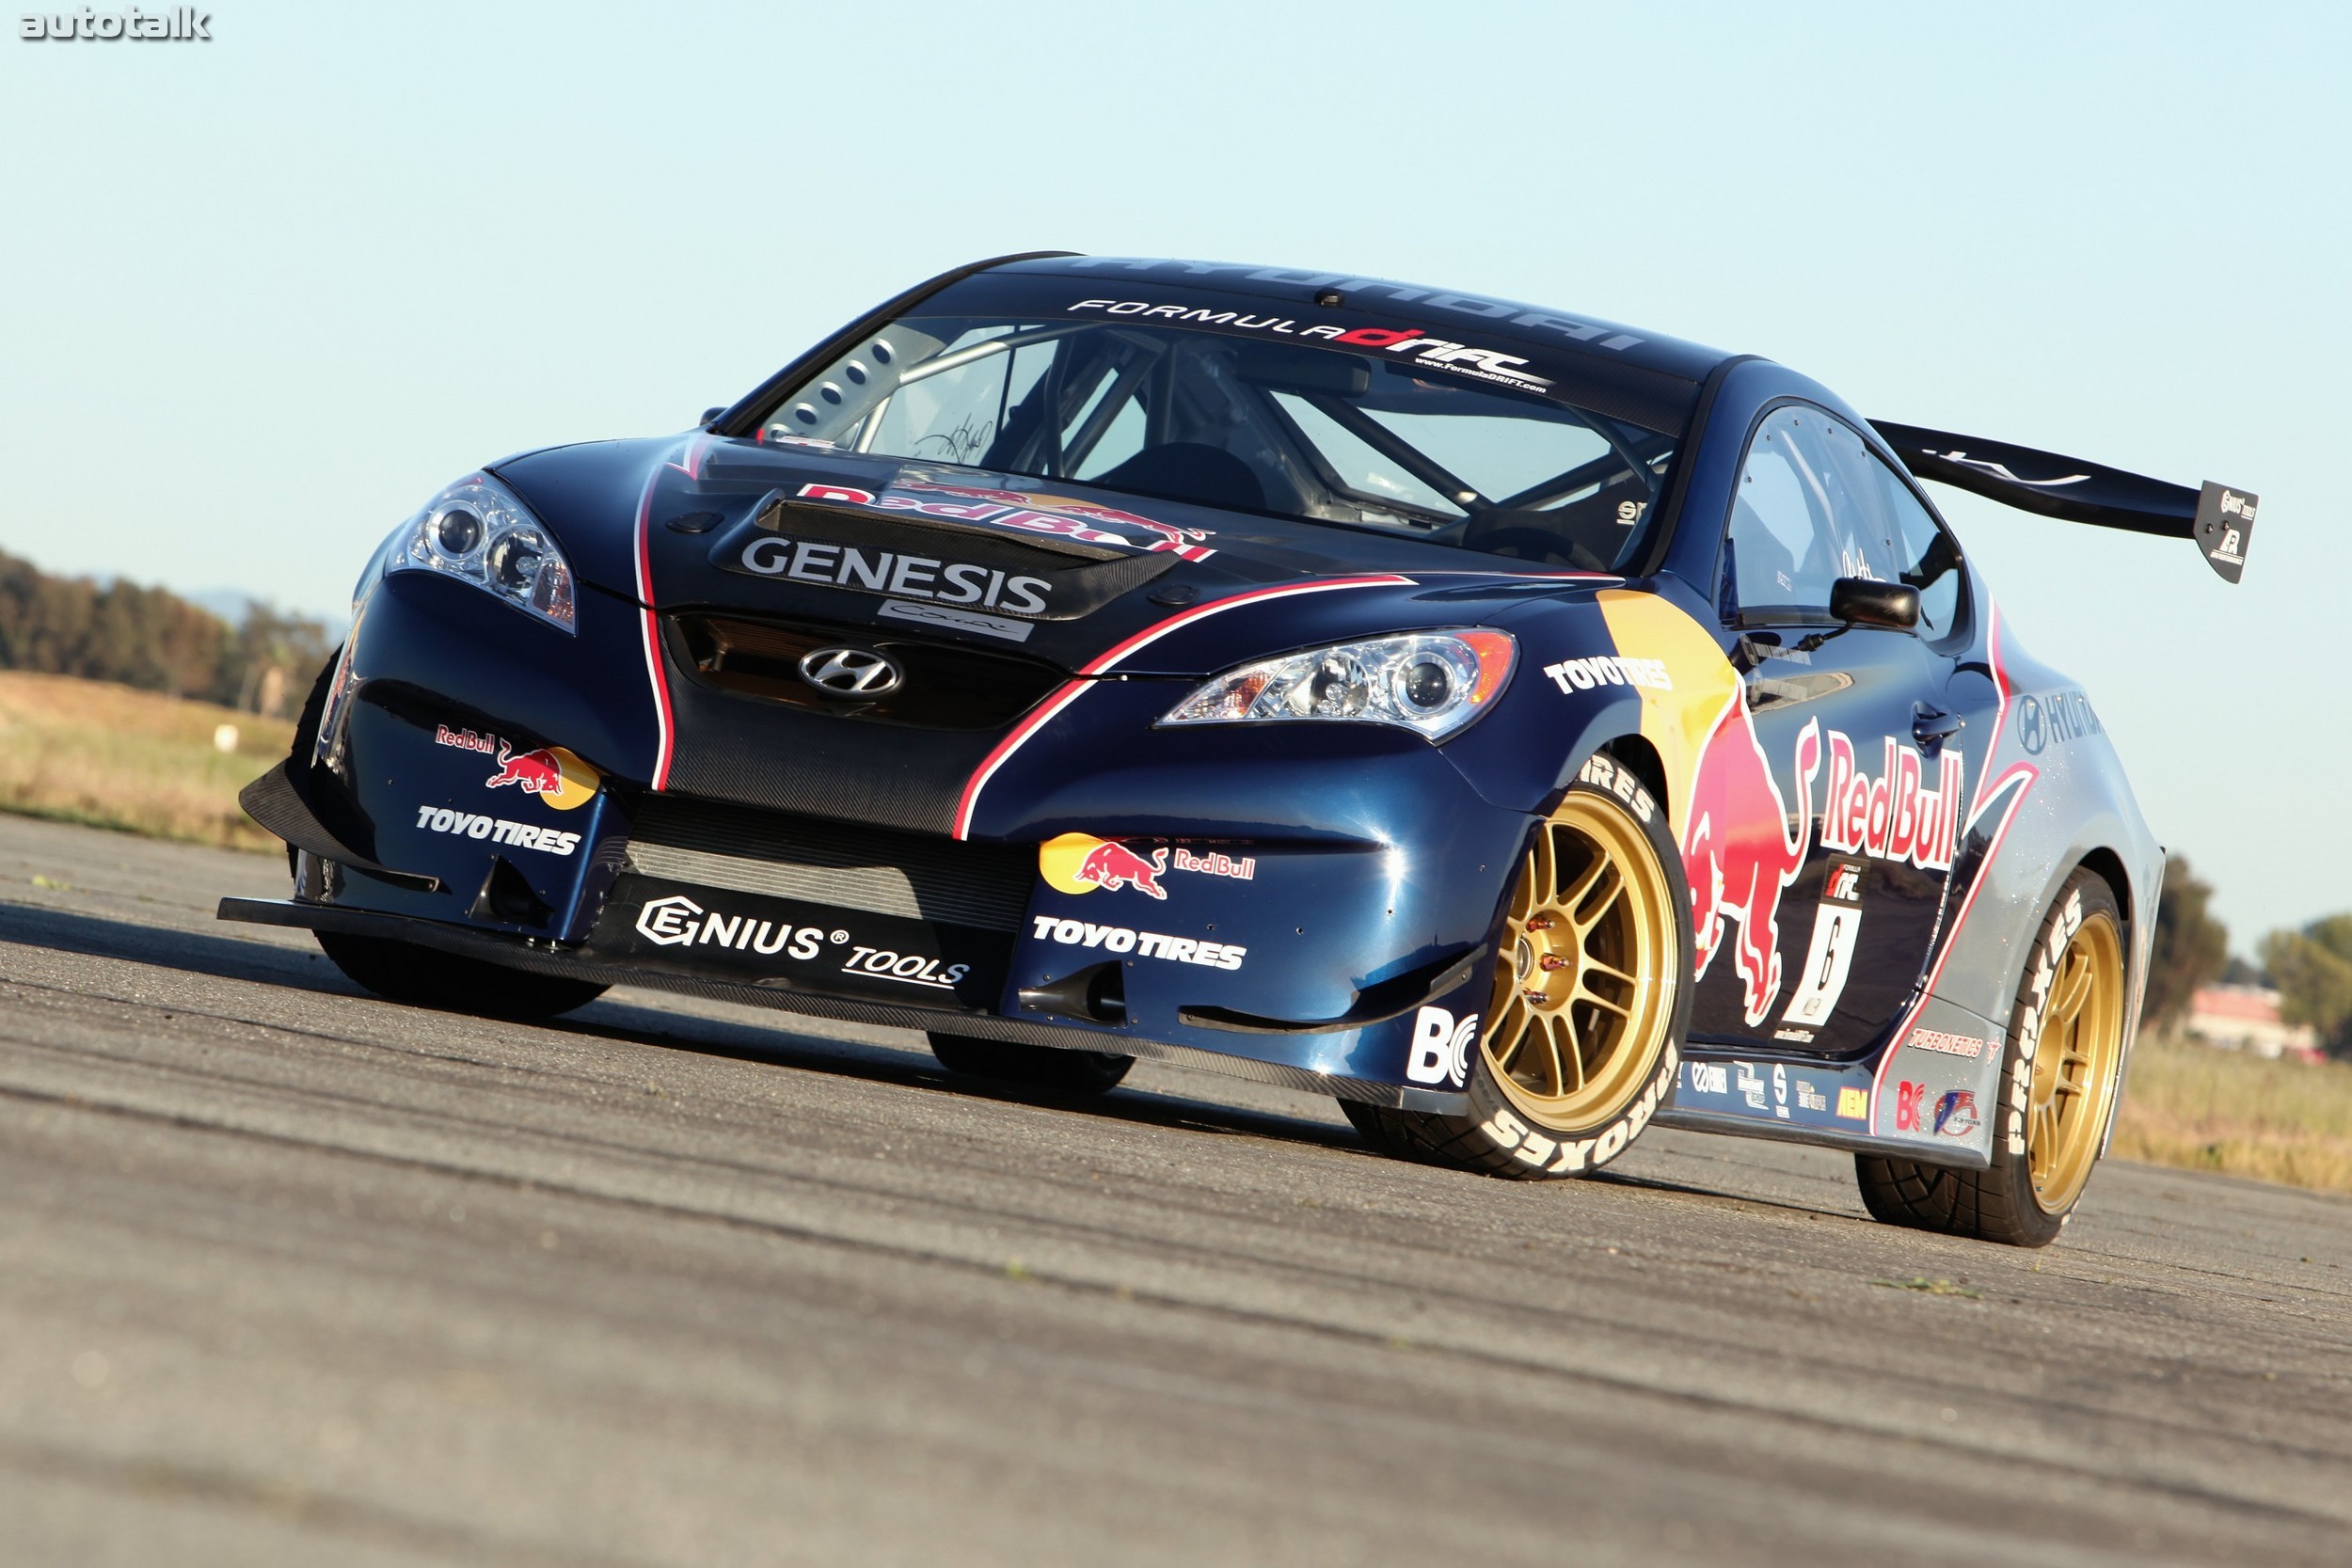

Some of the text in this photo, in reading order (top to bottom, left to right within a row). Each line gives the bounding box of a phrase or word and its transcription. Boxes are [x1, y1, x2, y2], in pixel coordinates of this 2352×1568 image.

[1068, 299, 1347, 341] FORMULA
[741, 536, 1053, 615] GENESIS
[843, 946, 970, 986] TOOLS
[1817, 915, 1842, 990] 6
[2009, 889, 2082, 1154] PROXES
[1482, 1037, 1678, 1173] PROXES
[1836, 1086, 1869, 1121] AEM
